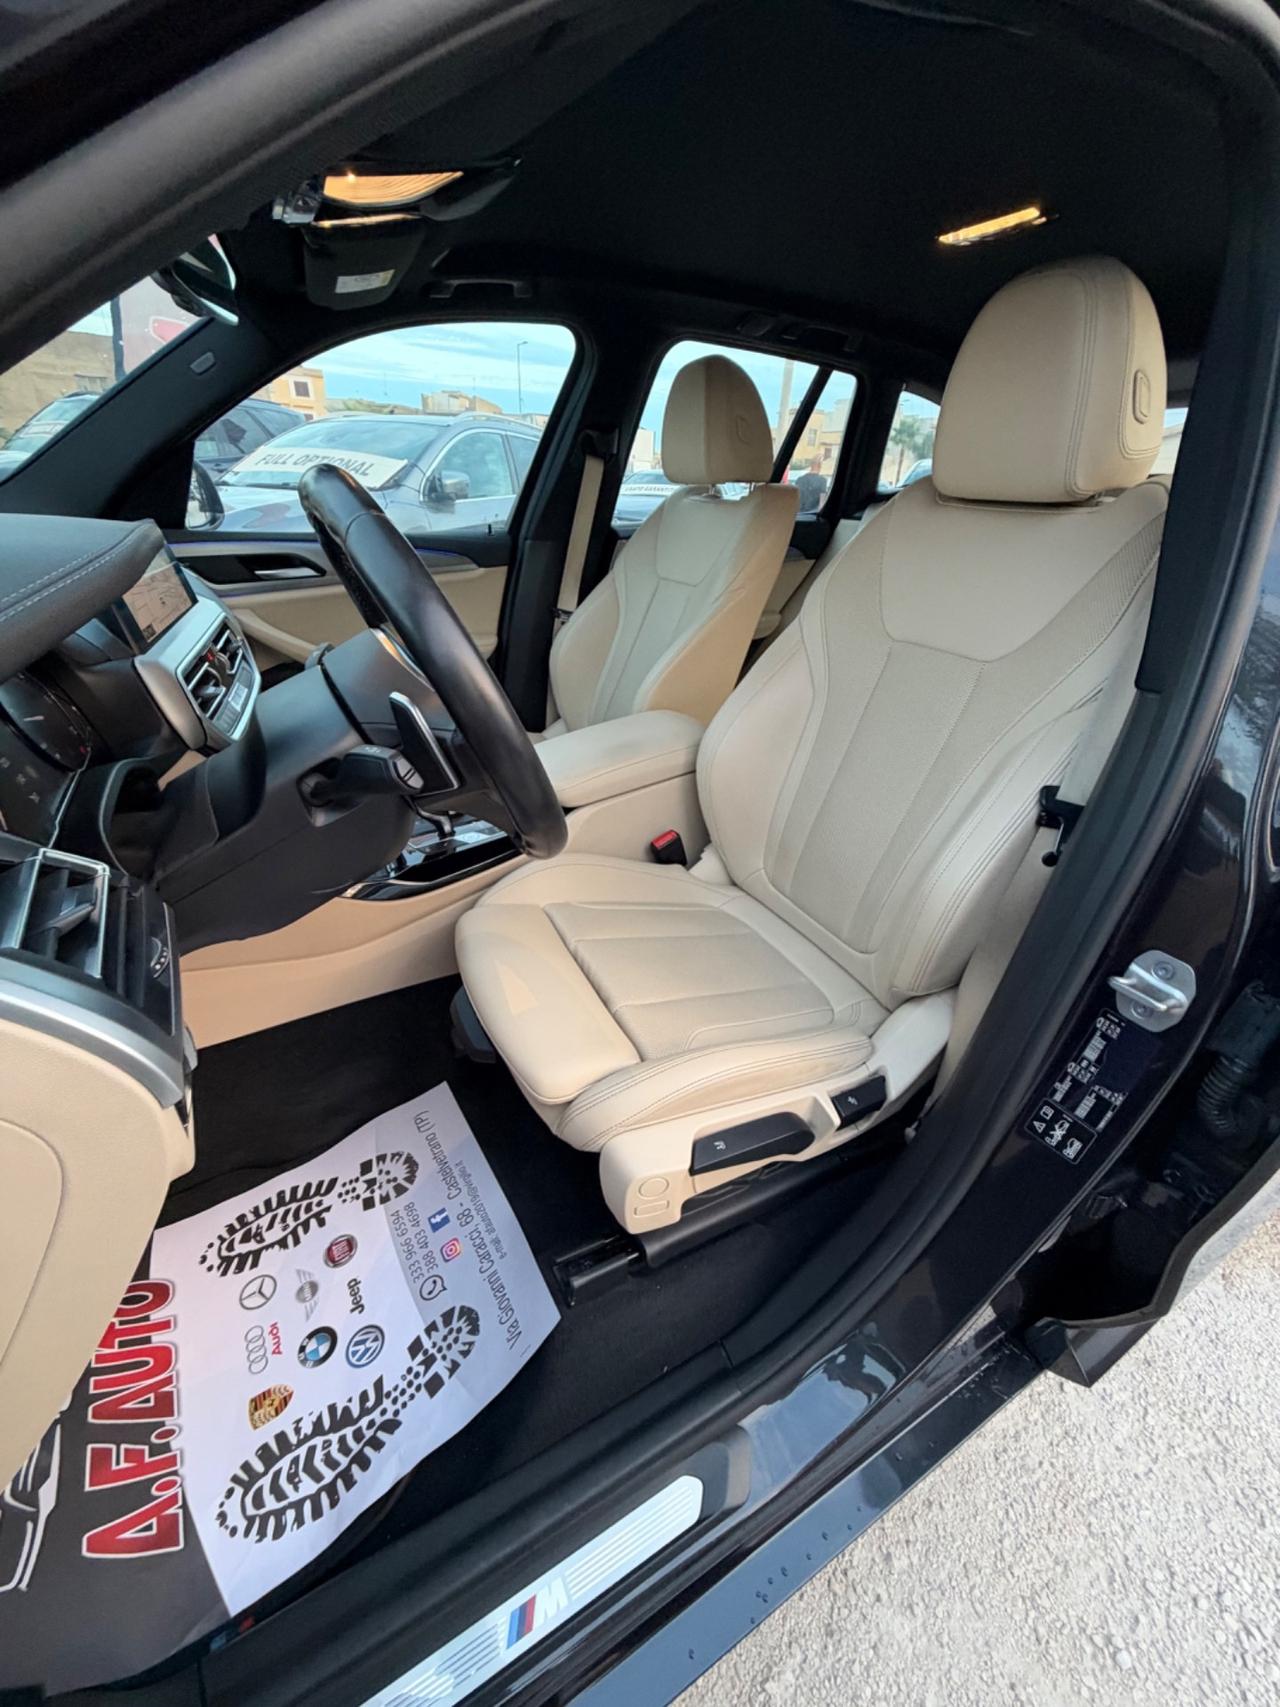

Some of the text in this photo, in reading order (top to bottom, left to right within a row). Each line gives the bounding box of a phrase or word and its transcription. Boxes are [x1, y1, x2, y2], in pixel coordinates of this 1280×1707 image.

[254, 453, 375, 477] FULL OPTIONAL
[413, 1110, 437, 1134] (TP)
[424, 1132, 463, 1201] Castelvetrano
[456, 1208, 475, 1228] 68
[390, 1209, 425, 1284] 333 966 6594
[403, 1201, 439, 1274] 388 403 4698
[464, 1223, 495, 1274] Caracci,
[346, 1277, 365, 1315] Jeep
[481, 1268, 515, 1326] Giovanni
[267, 1321, 283, 1355] Audi
[506, 1317, 523, 1351] Via
